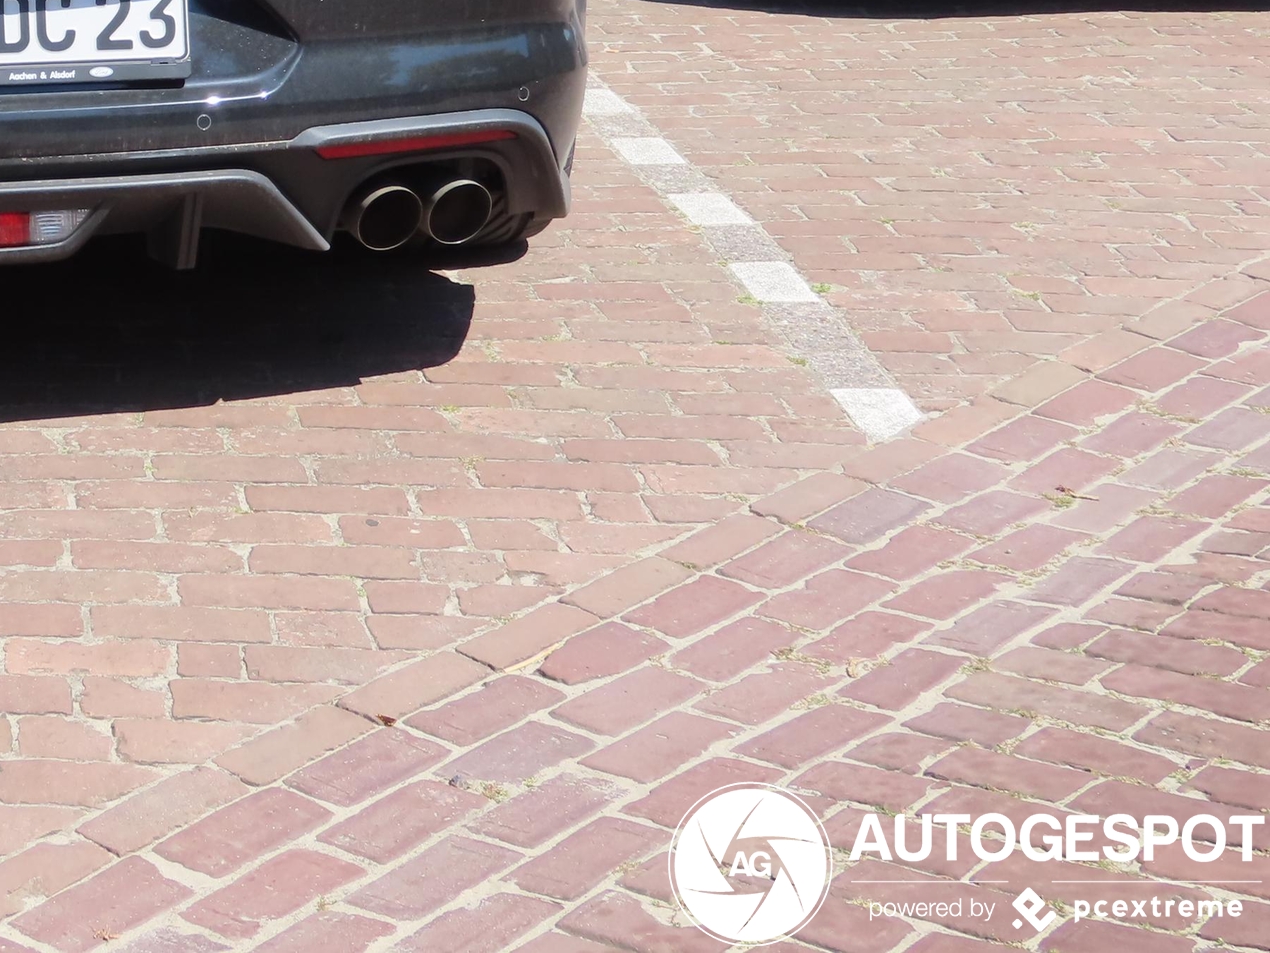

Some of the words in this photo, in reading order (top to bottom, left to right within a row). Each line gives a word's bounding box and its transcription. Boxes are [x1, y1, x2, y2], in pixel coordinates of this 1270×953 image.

[8, 72, 37, 81] Aachen
[39, 71, 47, 80] &
[49, 69, 76, 79] Alsdorf
